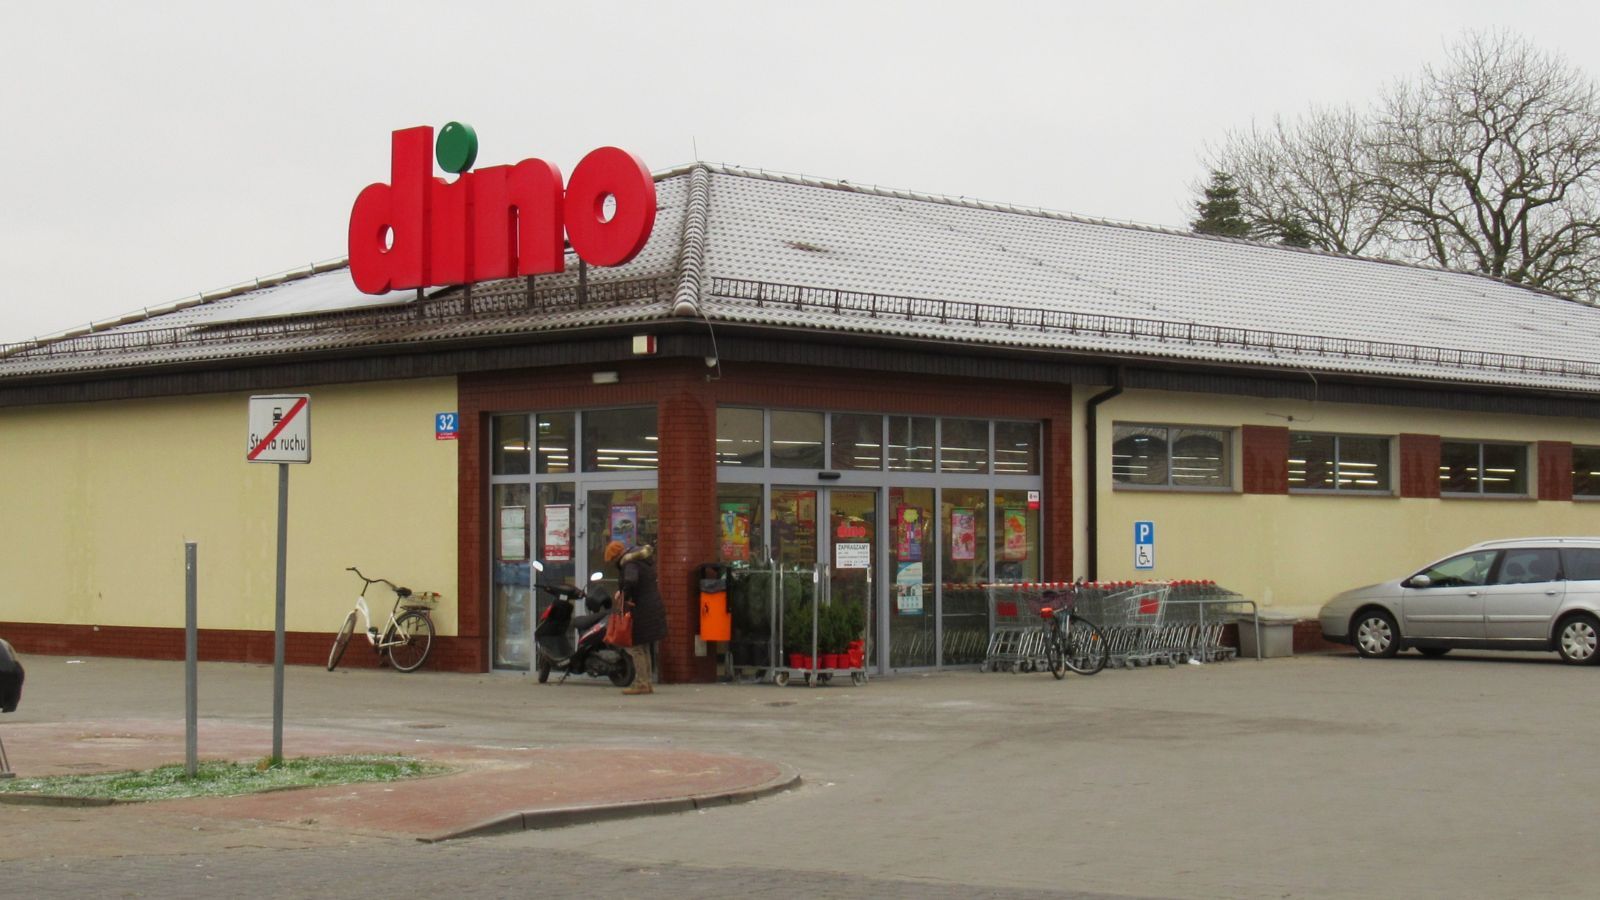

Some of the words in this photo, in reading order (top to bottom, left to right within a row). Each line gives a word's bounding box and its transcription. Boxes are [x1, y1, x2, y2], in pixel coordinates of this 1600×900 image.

[348, 121, 657, 295] dino
[440, 414, 454, 430] 32
[280, 433, 306, 451] ruchu
[1140, 524, 1149, 542] P
